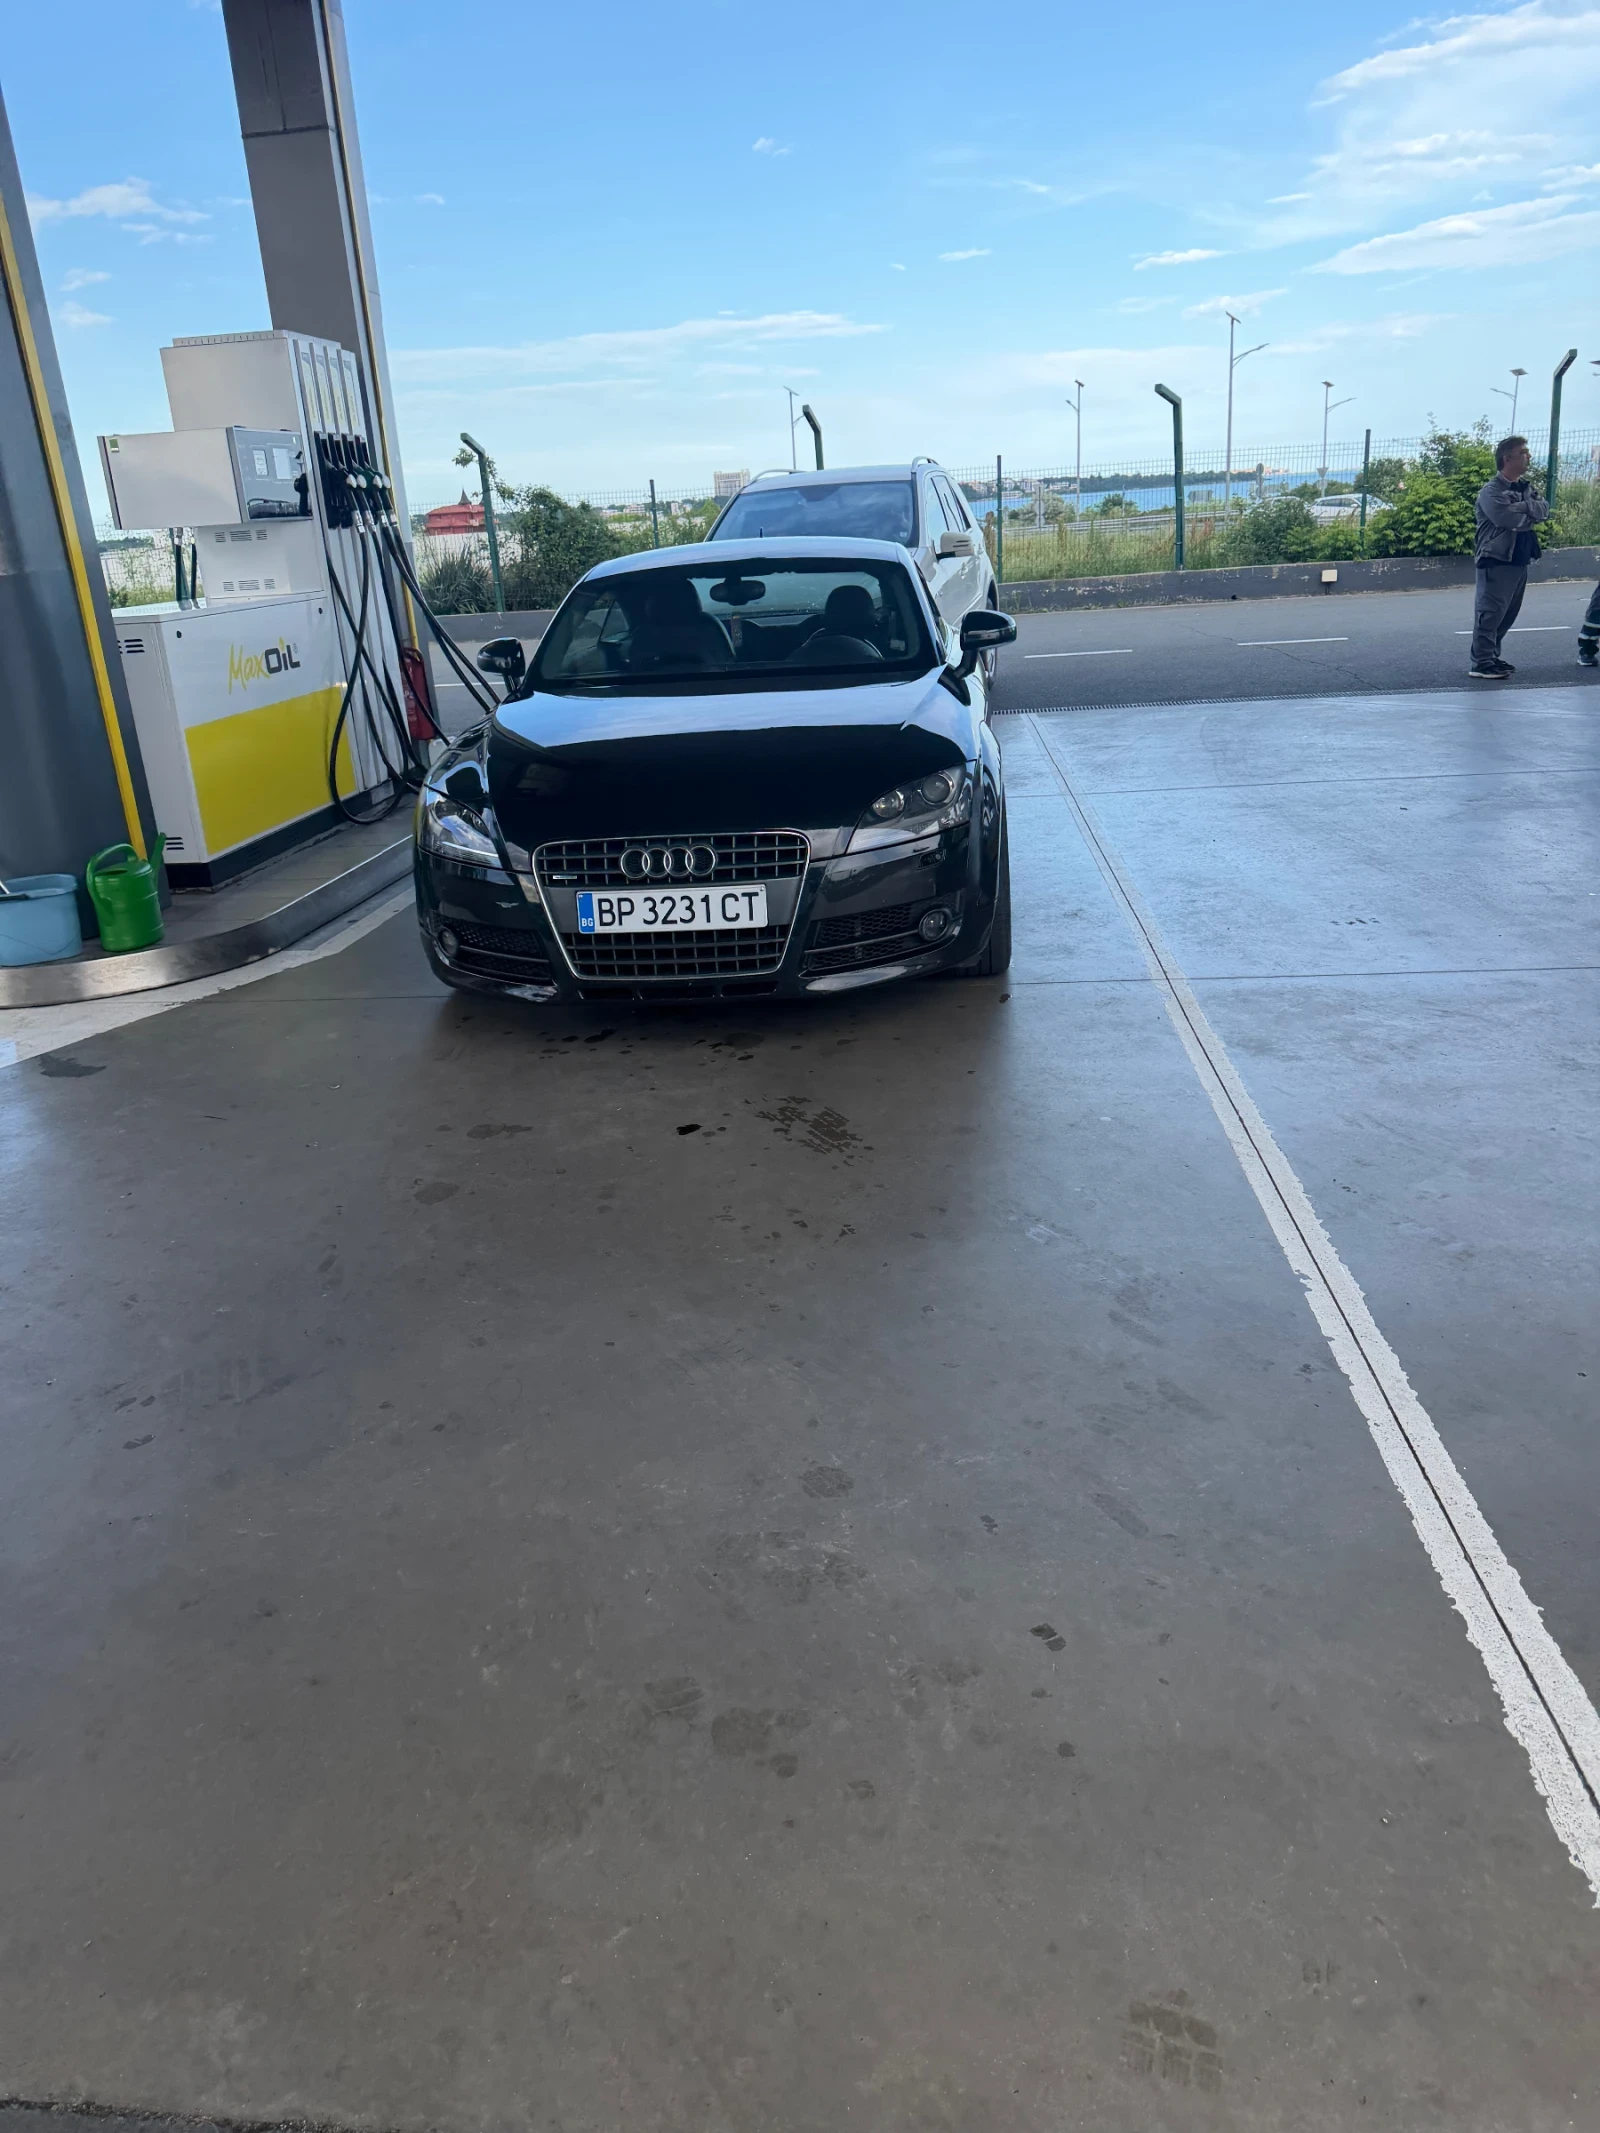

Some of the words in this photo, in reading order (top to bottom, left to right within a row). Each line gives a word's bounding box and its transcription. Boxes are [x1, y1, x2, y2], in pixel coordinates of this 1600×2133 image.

[597, 897, 635, 927] BP
[642, 895, 712, 925] 3231
[721, 891, 760, 923] CT
[581, 918, 594, 927] BG
